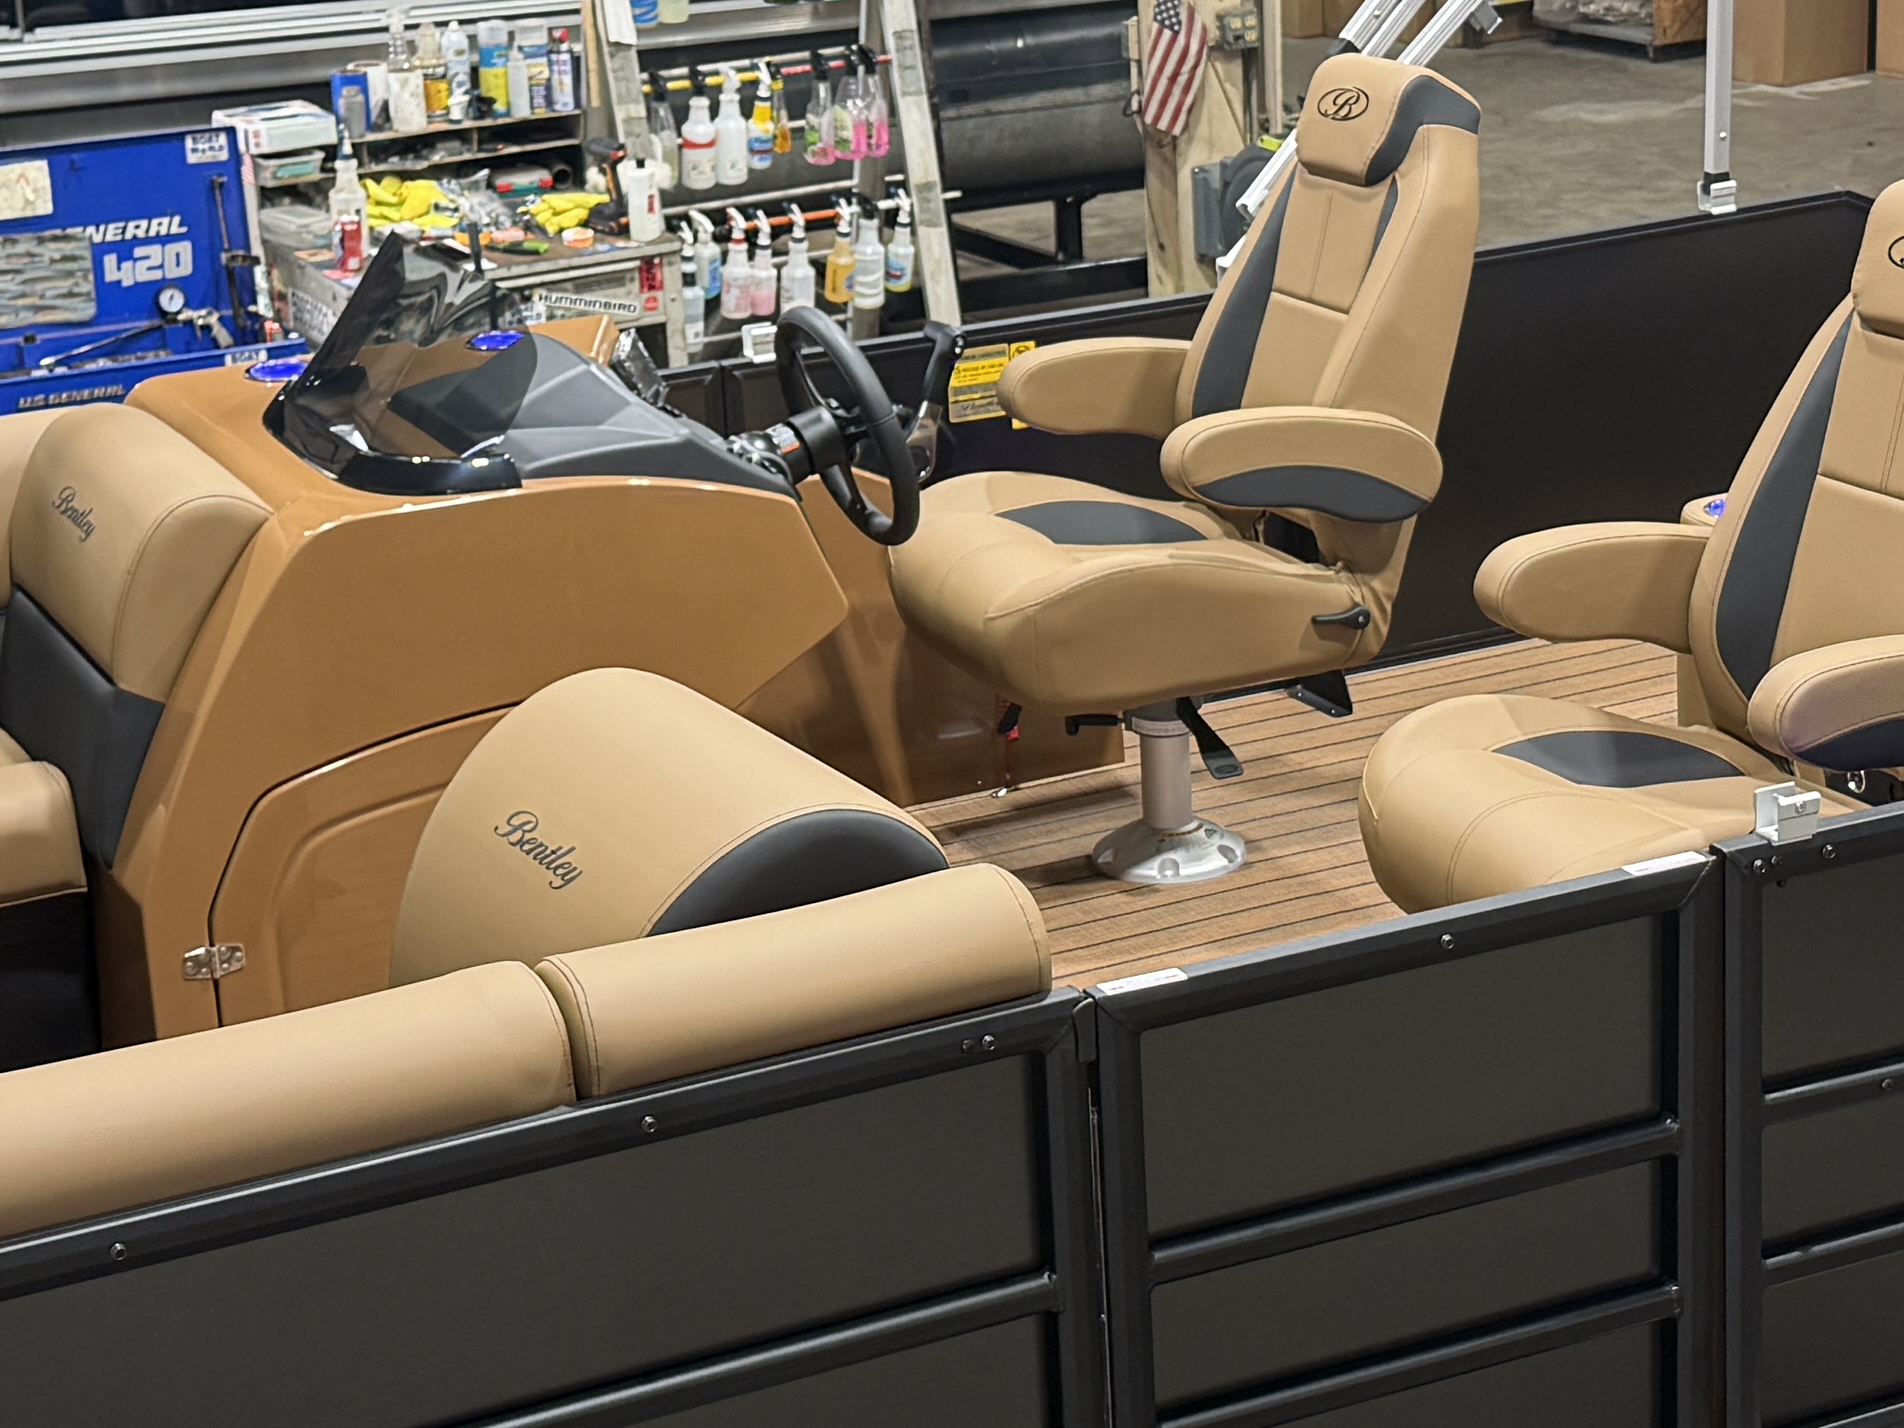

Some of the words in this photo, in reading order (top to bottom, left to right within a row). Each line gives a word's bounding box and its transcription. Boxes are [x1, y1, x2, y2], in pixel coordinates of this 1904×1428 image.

[44, 215, 189, 244] NERAL
[103, 240, 193, 288] 420
[538, 292, 638, 314] HUMMINBIRD
[52, 486, 95, 543] Bentley
[494, 810, 583, 890] Bentley
